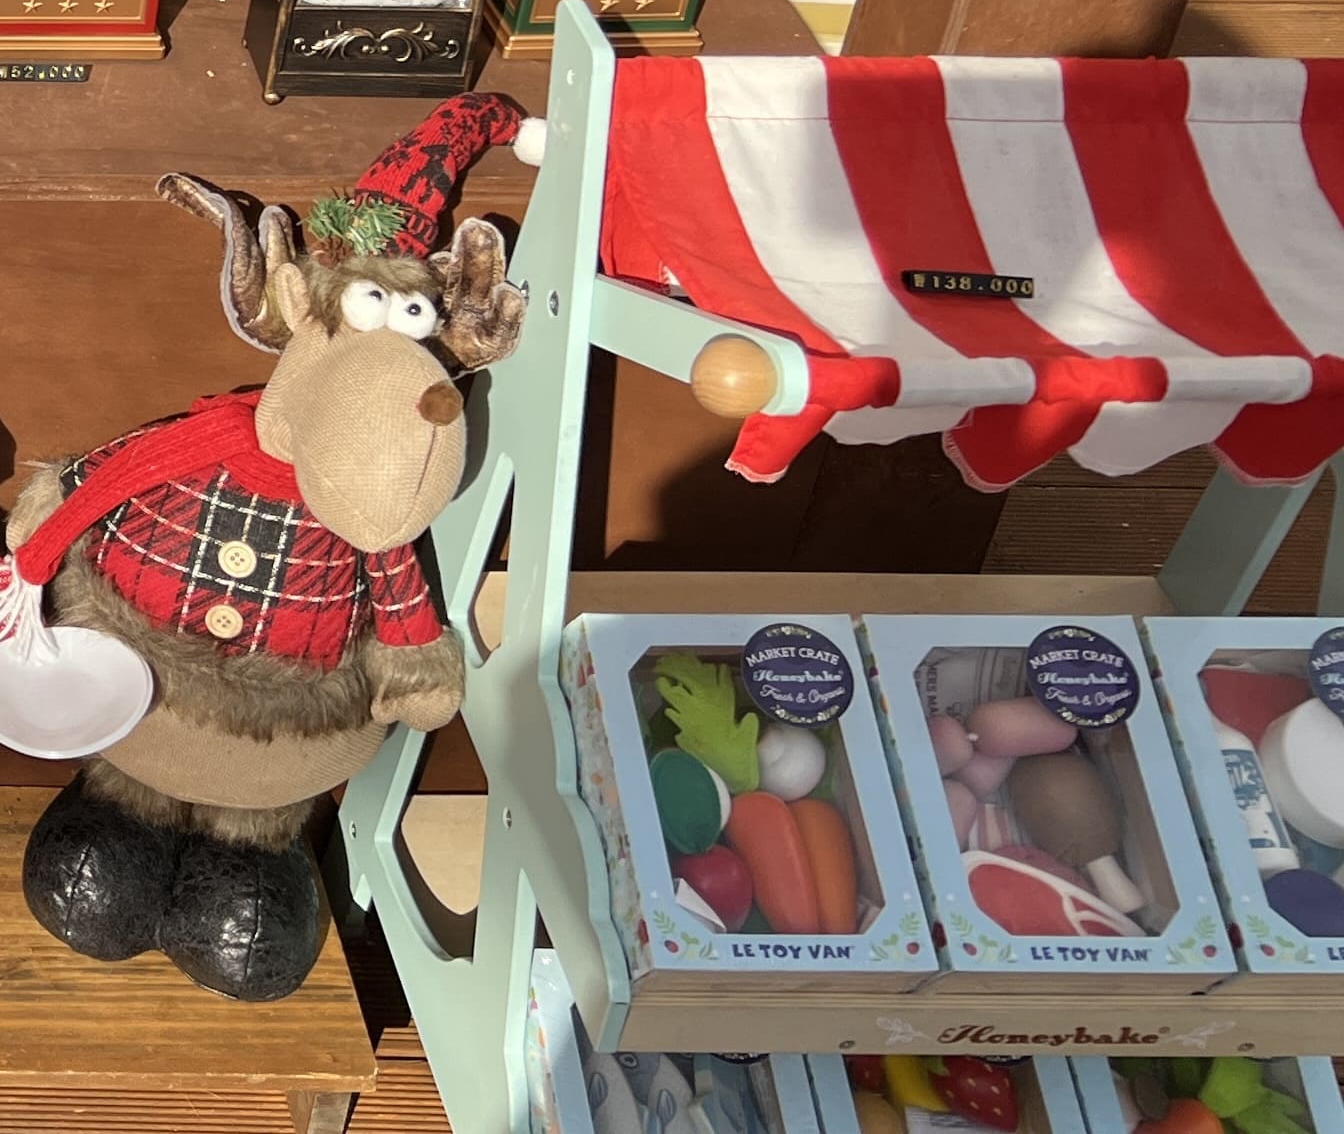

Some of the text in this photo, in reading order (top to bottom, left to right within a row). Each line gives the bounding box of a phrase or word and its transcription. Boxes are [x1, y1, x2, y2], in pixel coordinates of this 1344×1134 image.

[745, 646, 840, 667] MARKET CRATE
[1028, 649, 1125, 670] MARKET CRATE
[732, 944, 851, 960] LE TOY VAN
[1030, 945, 1150, 962] LE TOY VAN
[936, 1023, 1160, 1047] Honeybake
